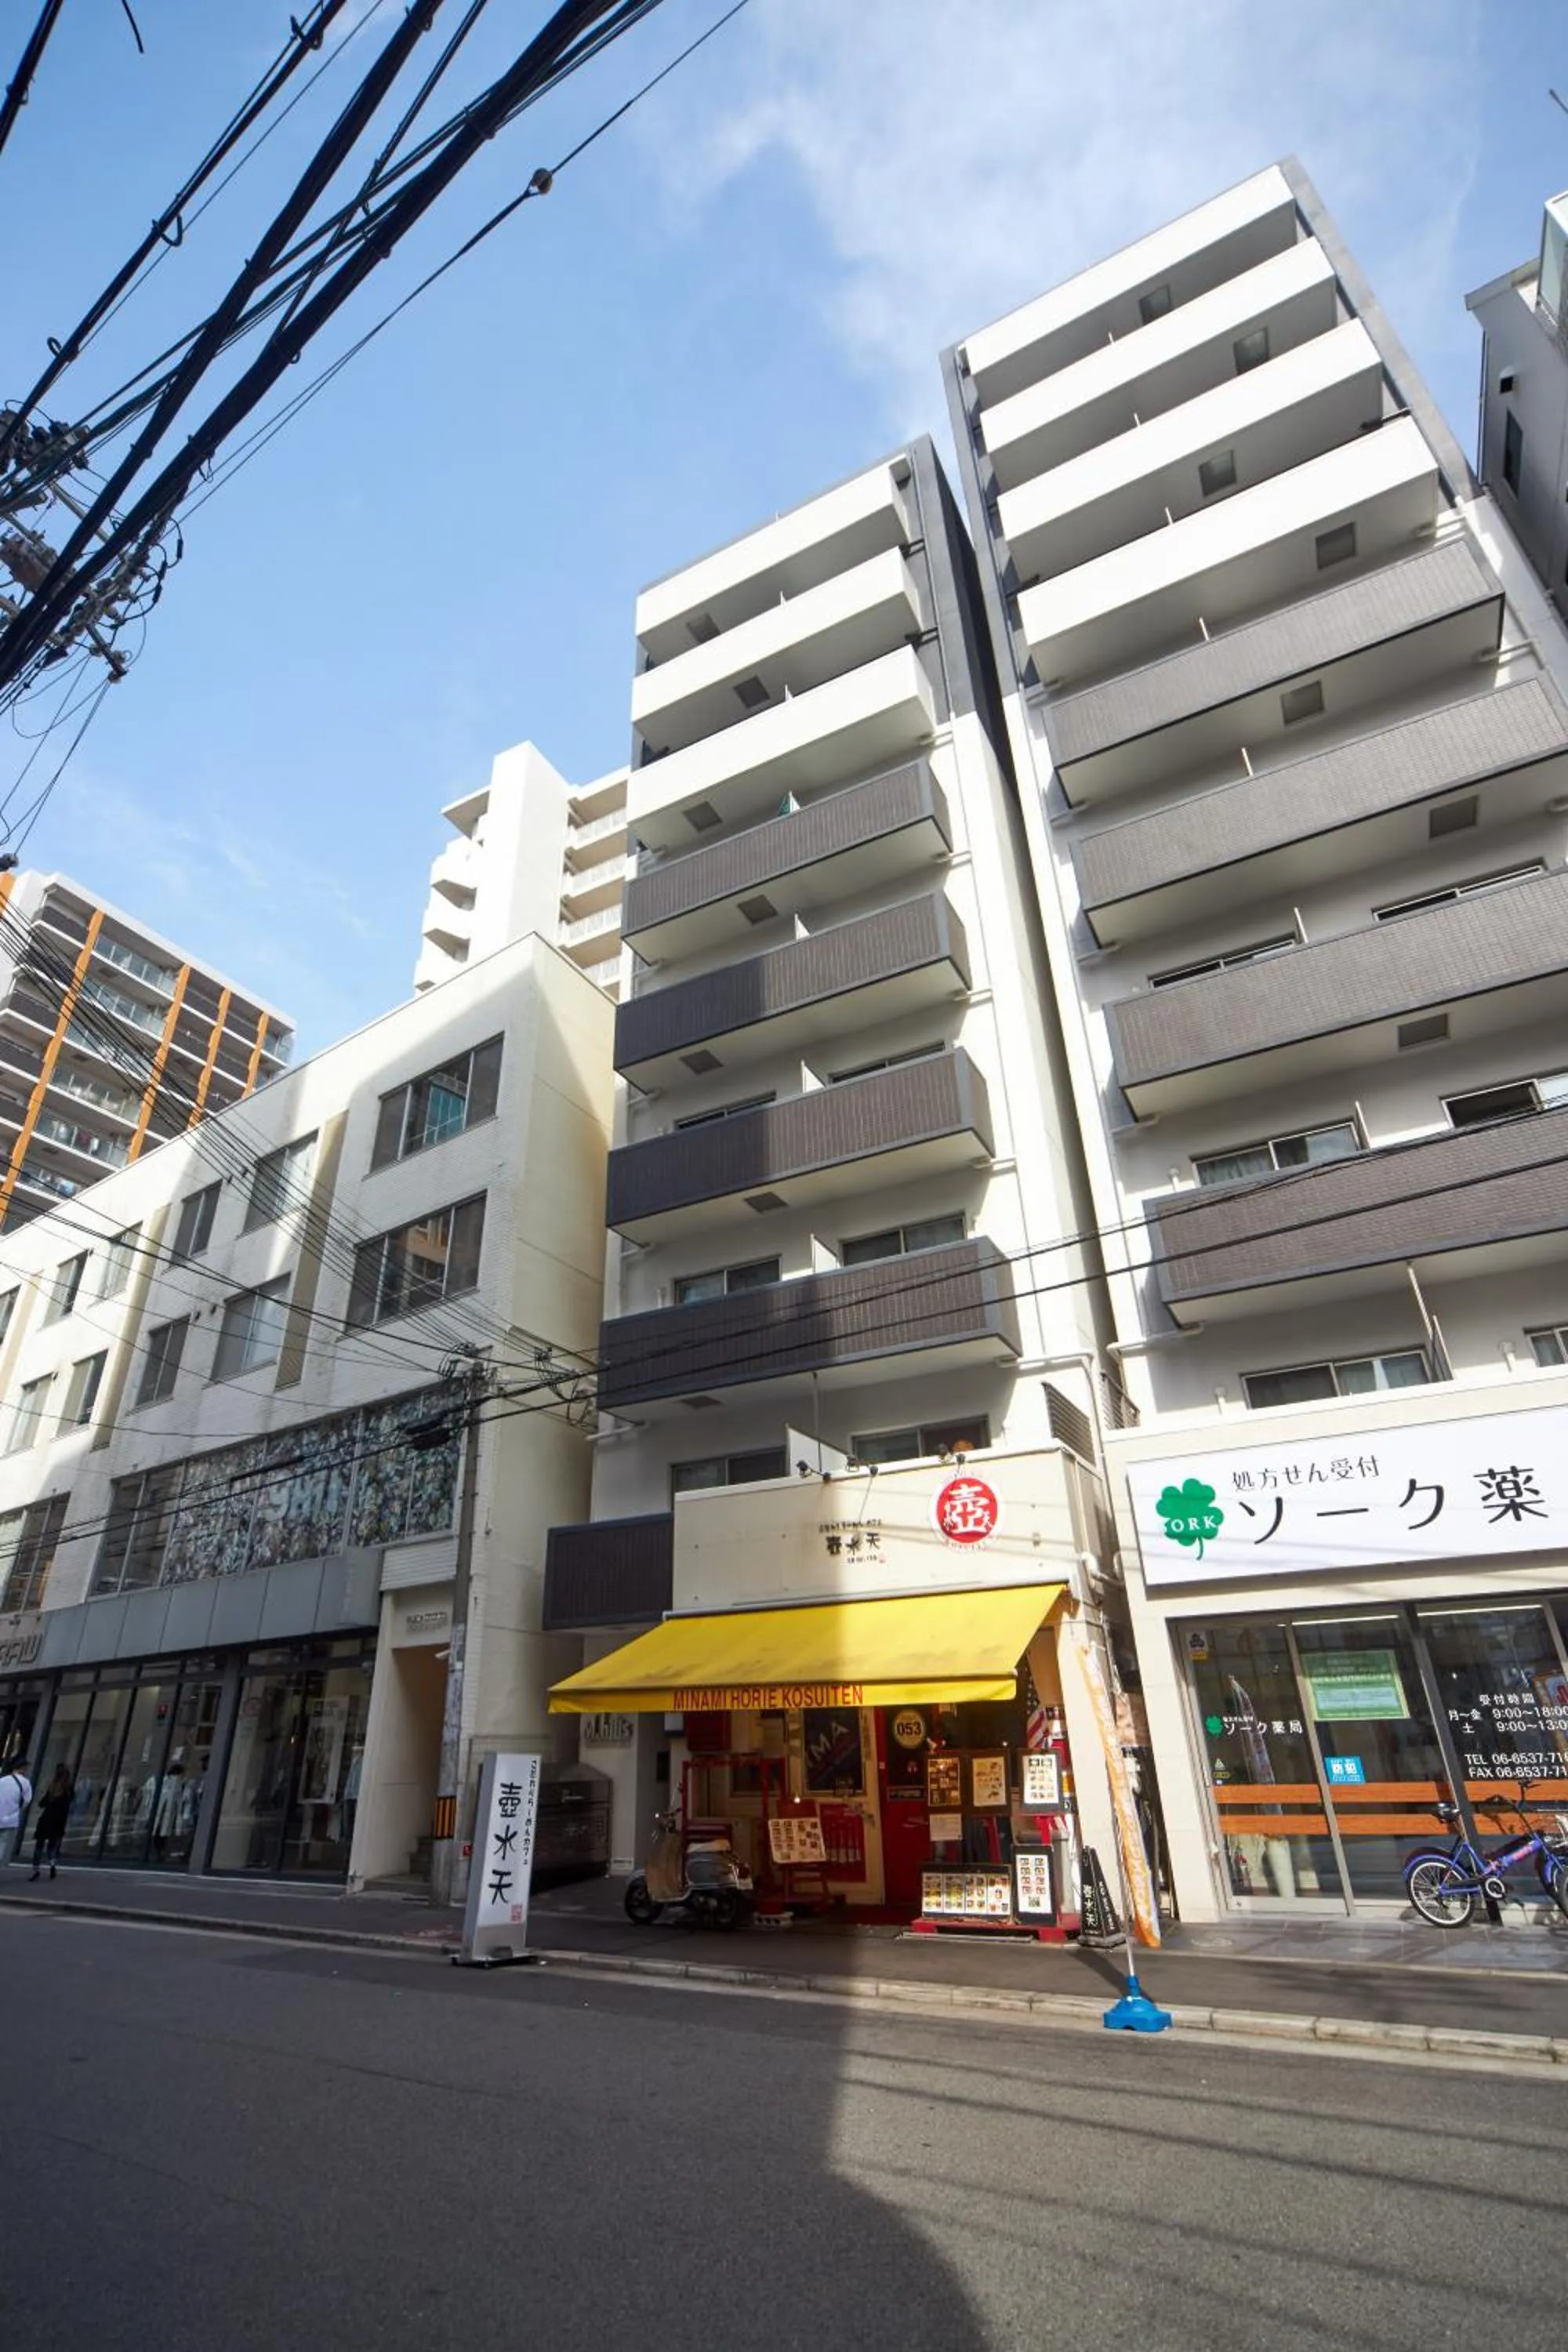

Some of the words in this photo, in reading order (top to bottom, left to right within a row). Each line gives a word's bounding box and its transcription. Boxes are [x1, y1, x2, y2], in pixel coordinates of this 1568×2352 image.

[1233, 1455, 1379, 1490] 処方せん受付
[1238, 1465, 1548, 1544] ソーク薬
[1164, 1515, 1218, 1533] ORK
[673, 1688, 727, 1710] MINAMI
[731, 1687, 778, 1708] HORIE
[782, 1682, 863, 1708] KOSUITEN
[1479, 1693, 1535, 1707] 受付時間
[896, 1722, 921, 1736] 053
[1462, 1722, 1475, 1733] 土
[1465, 1753, 1488, 1765] TEL
[1468, 1766, 1494, 1778] FAX
